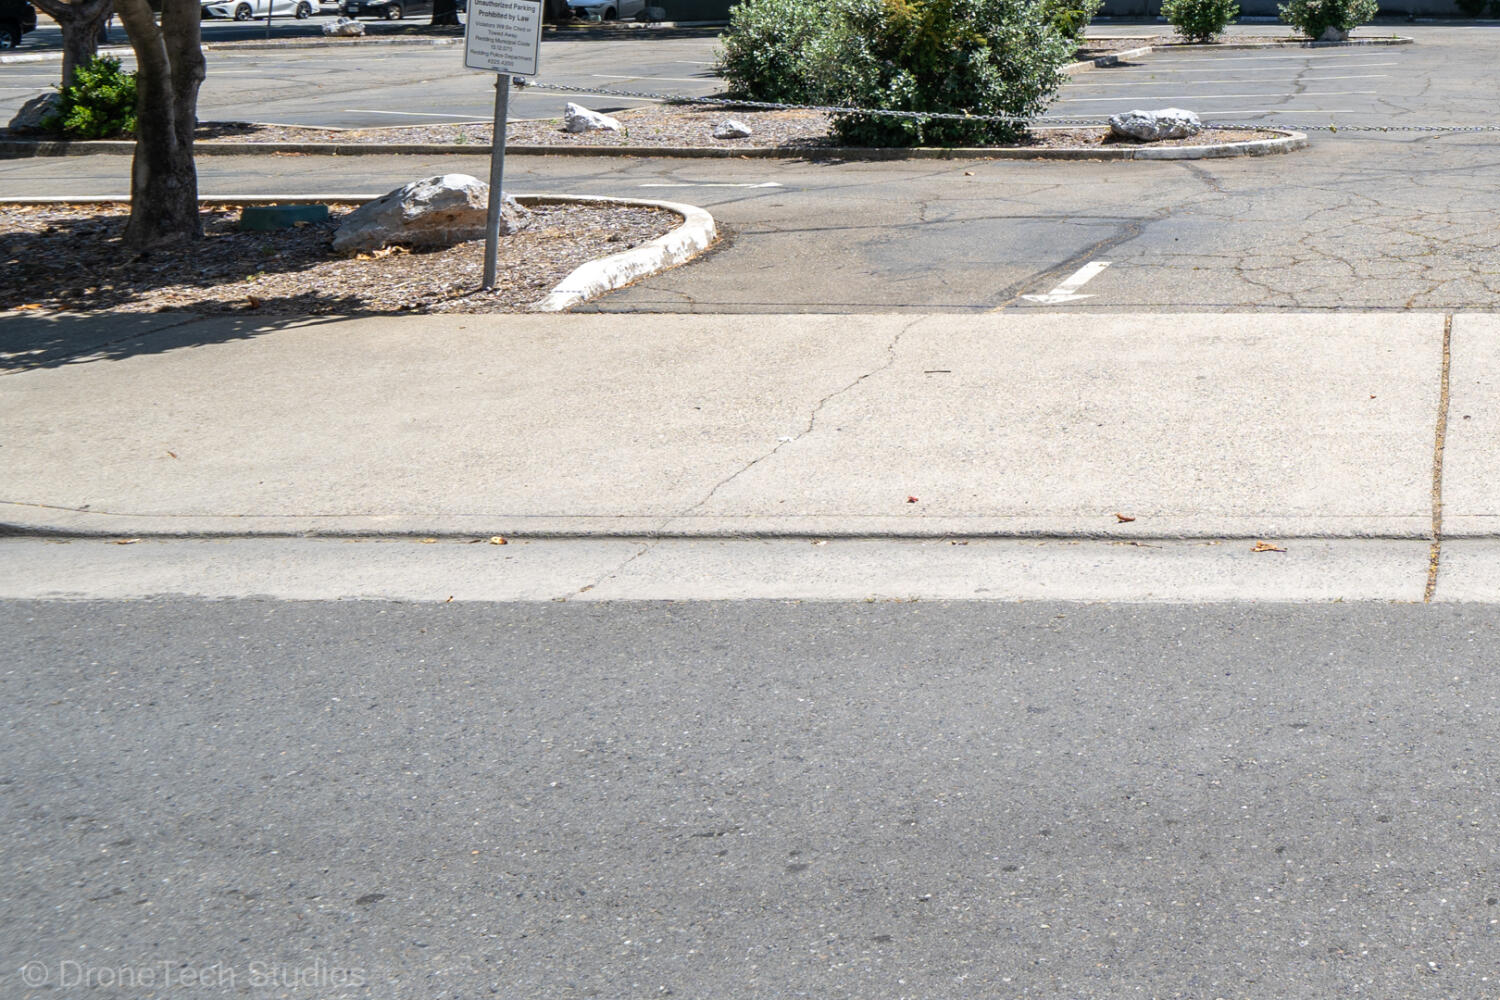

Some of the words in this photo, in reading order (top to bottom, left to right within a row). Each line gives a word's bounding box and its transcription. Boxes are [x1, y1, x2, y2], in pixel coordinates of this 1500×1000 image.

[513, 3, 536, 13] Parking
[478, 9, 507, 19] Prohibited
[508, 13, 516, 21] by
[517, 14, 530, 22] Law
